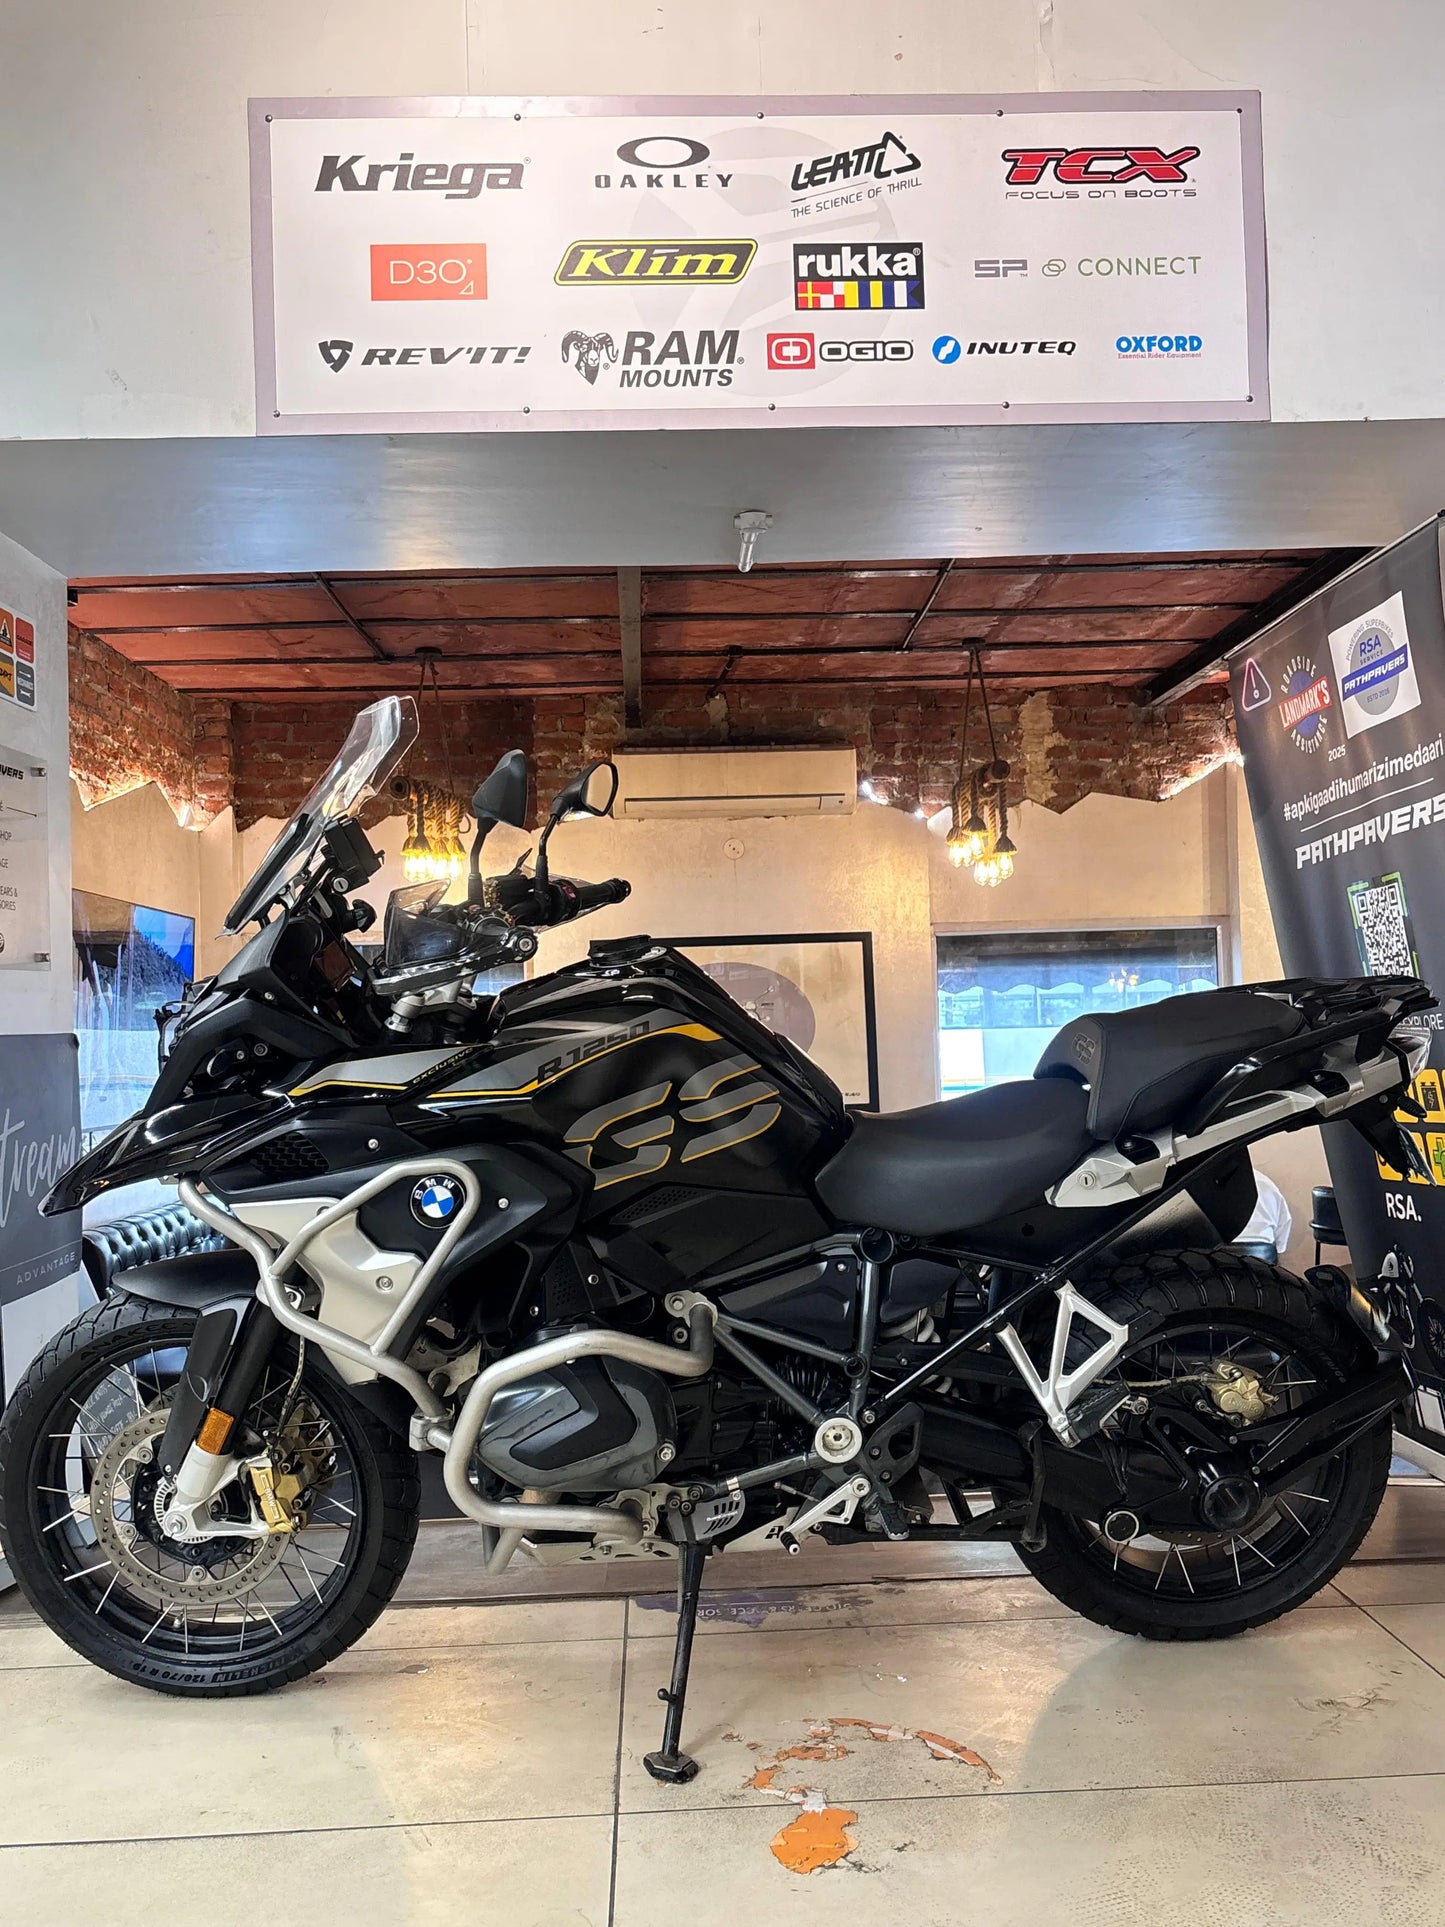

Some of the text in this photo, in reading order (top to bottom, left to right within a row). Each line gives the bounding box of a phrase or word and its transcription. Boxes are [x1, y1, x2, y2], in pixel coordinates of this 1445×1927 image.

[315, 152, 525, 200] Kriega
[595, 173, 733, 189] OAKLEY
[1001, 146, 1200, 186] TCX
[791, 177, 922, 218] THE SCIENCE OF THRILL
[1005, 190, 1080, 200] FOCUS
[1124, 189, 1197, 198] BOOTS
[798, 245, 917, 277] rukka
[974, 256, 1202, 278] SP CONNECT
[361, 346, 531, 366] REV'IT!
[621, 330, 740, 366] RAM
[819, 340, 913, 362] OGIO
[966, 341, 1077, 356] INUTEQ
[1116, 335, 1202, 353] OXFORD
[619, 368, 734, 387] MOUNTS
[1359, 634, 1382, 657] RSA
[1359, 649, 1384, 665] SERVICE
[1280, 655, 1317, 694] ROADSIDE
[1344, 653, 1406, 693] PATHPAVERS
[1279, 679, 1331, 728] LANDMARK'S
[1290, 714, 1328, 754] ASSISTANCE
[1328, 744, 1347, 762] 2025
[1295, 792, 1445, 870] PATHPAVERS
[412, 1047, 474, 1084] exclusive
[538, 1020, 650, 1084] R 1250
[562, 1052, 783, 1191] GS
[414, 1178, 455, 1200] BMW
[1385, 1192, 1422, 1222] RSA.
[16, 1252, 76, 1286] ADVANTAGE
